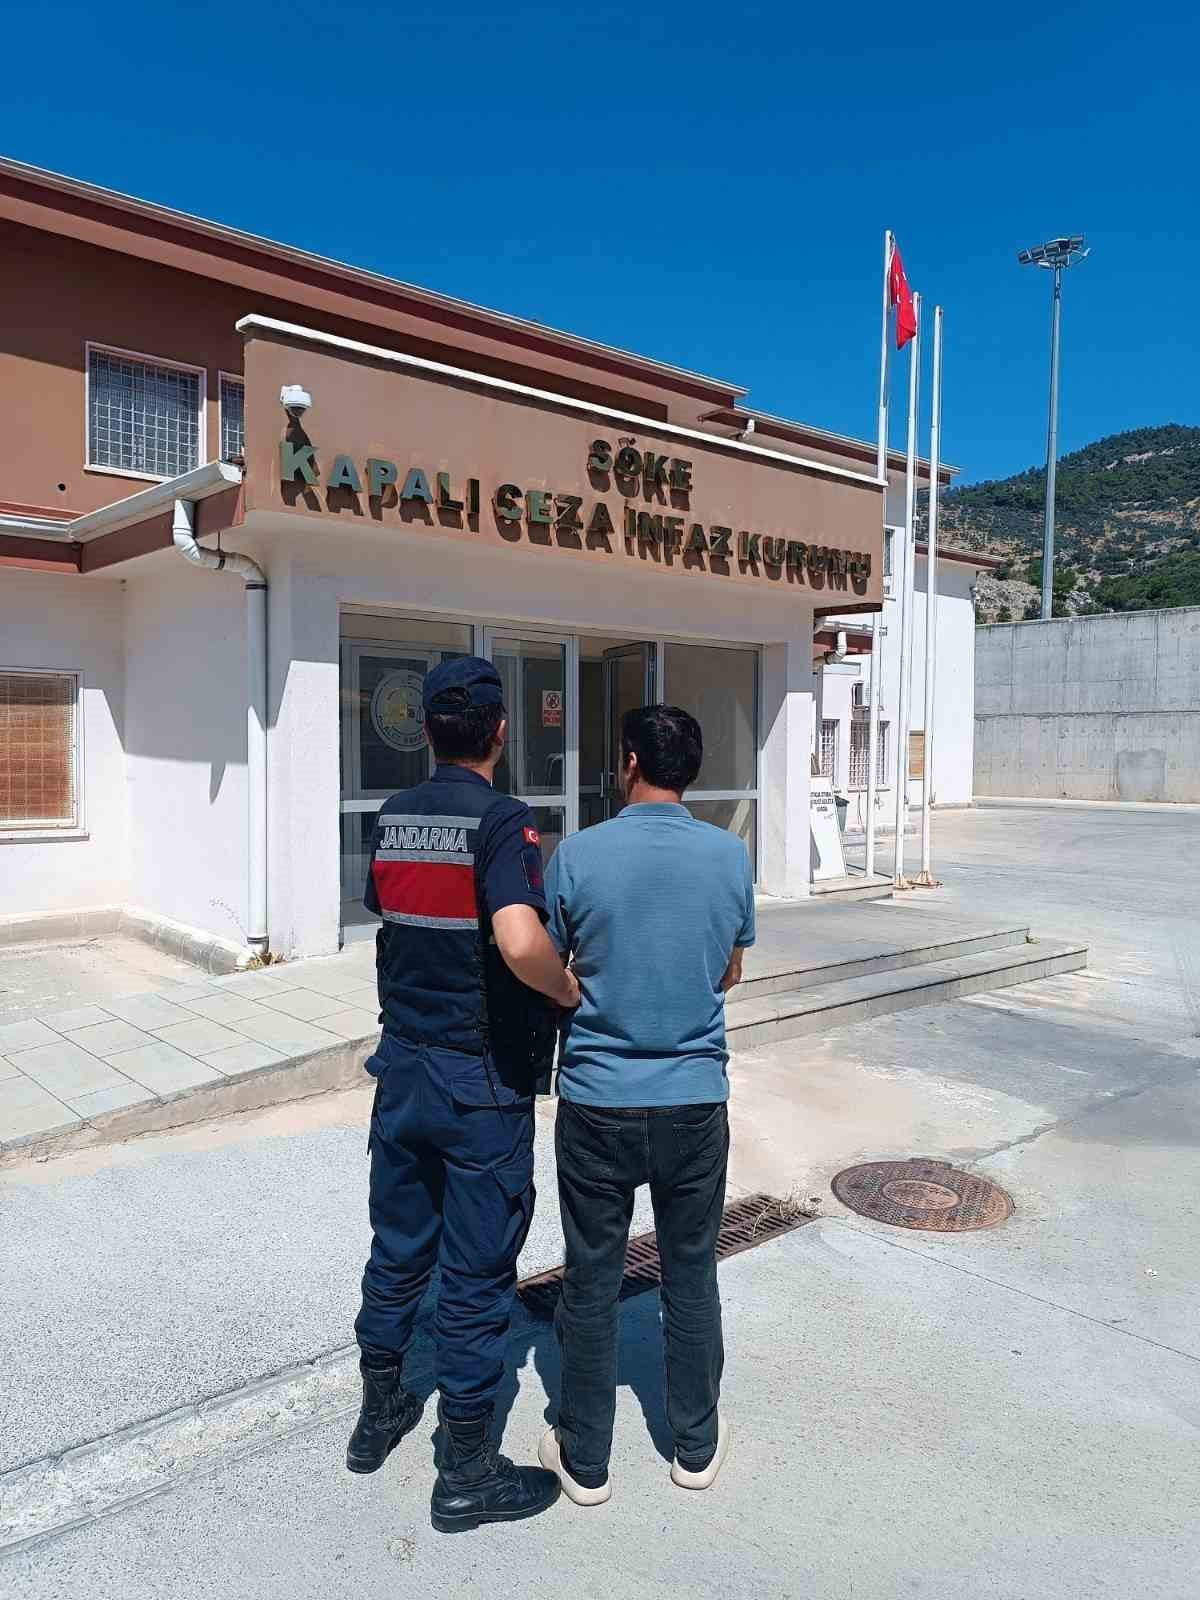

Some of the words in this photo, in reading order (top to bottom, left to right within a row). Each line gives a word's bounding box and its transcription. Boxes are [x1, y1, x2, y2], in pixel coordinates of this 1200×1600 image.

[589, 438, 693, 493] SÖKE
[279, 441, 480, 517] KAPALI
[737, 531, 872, 582] KURUMU
[380, 826, 468, 852] JANDARMA
